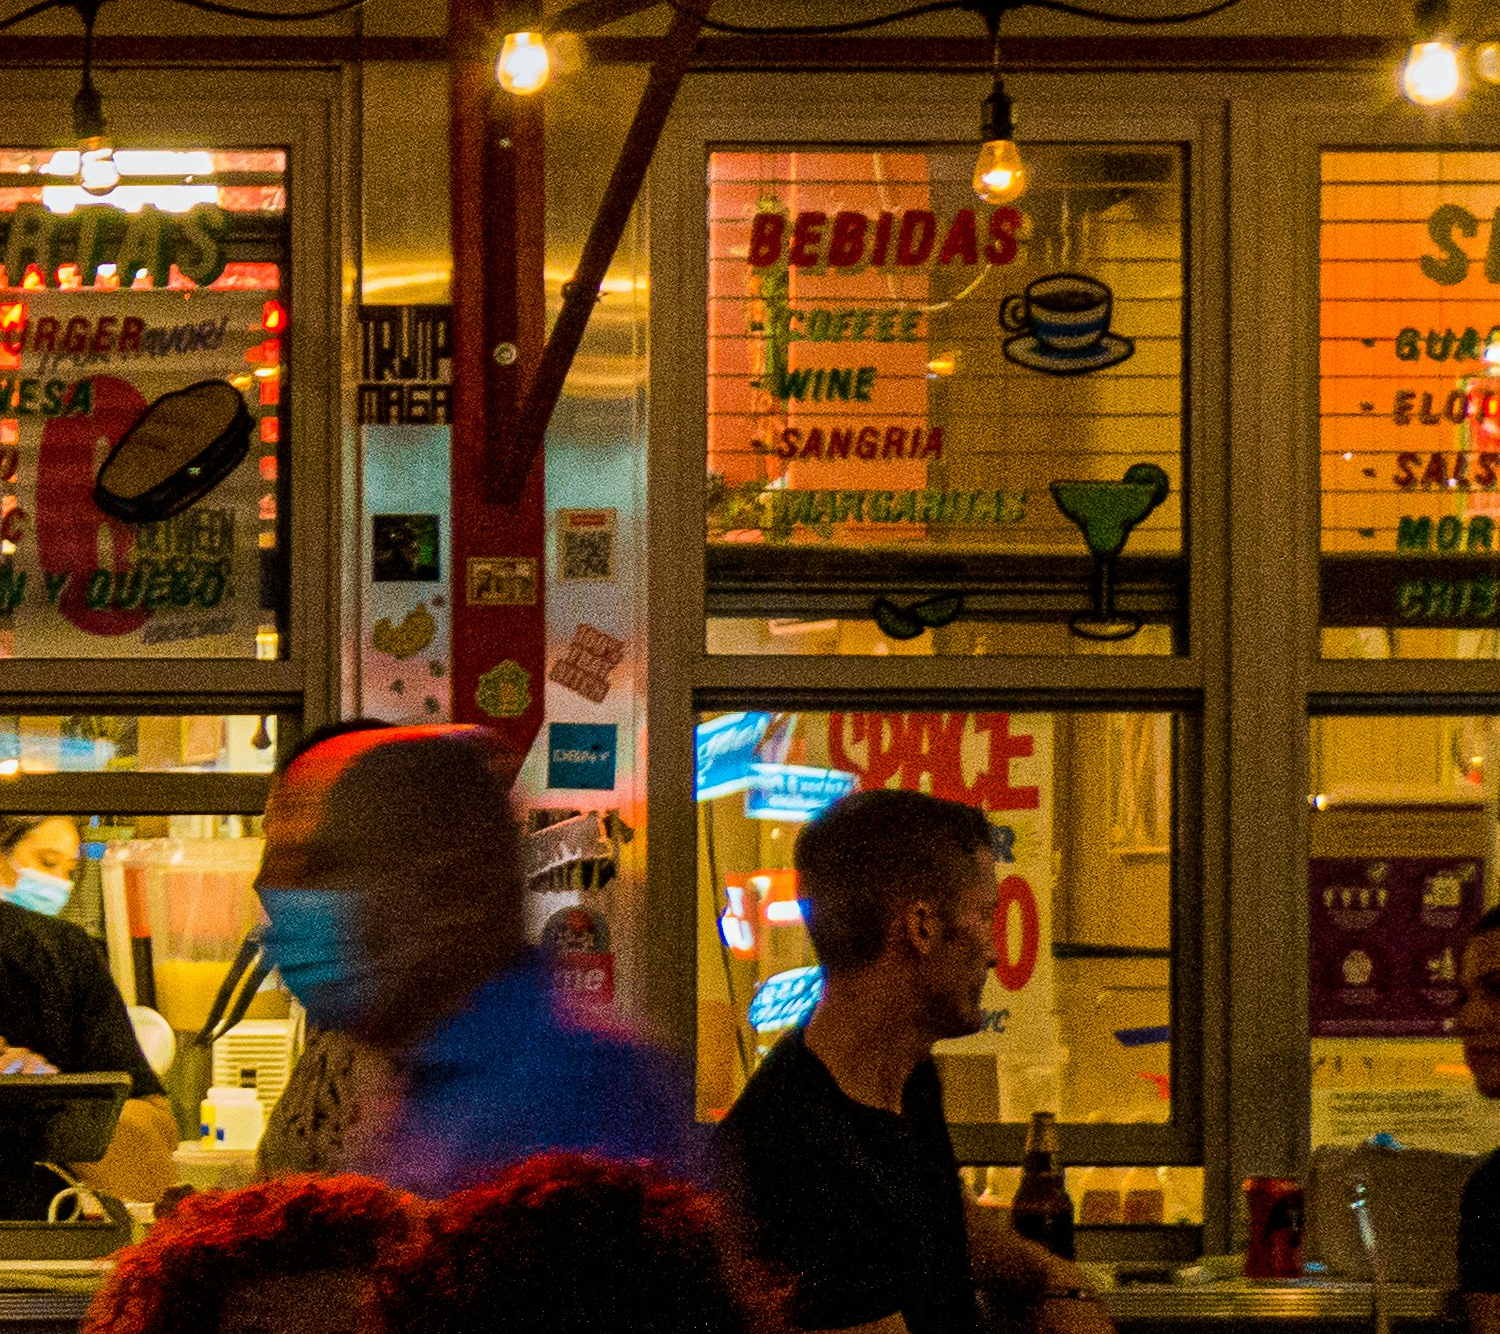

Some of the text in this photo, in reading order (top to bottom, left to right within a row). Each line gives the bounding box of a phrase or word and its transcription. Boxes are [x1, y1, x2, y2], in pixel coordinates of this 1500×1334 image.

[747, 207, 1024, 271] BEBIDAS
[778, 368, 879, 403] WINE
[777, 427, 945, 461] SANGRIA
